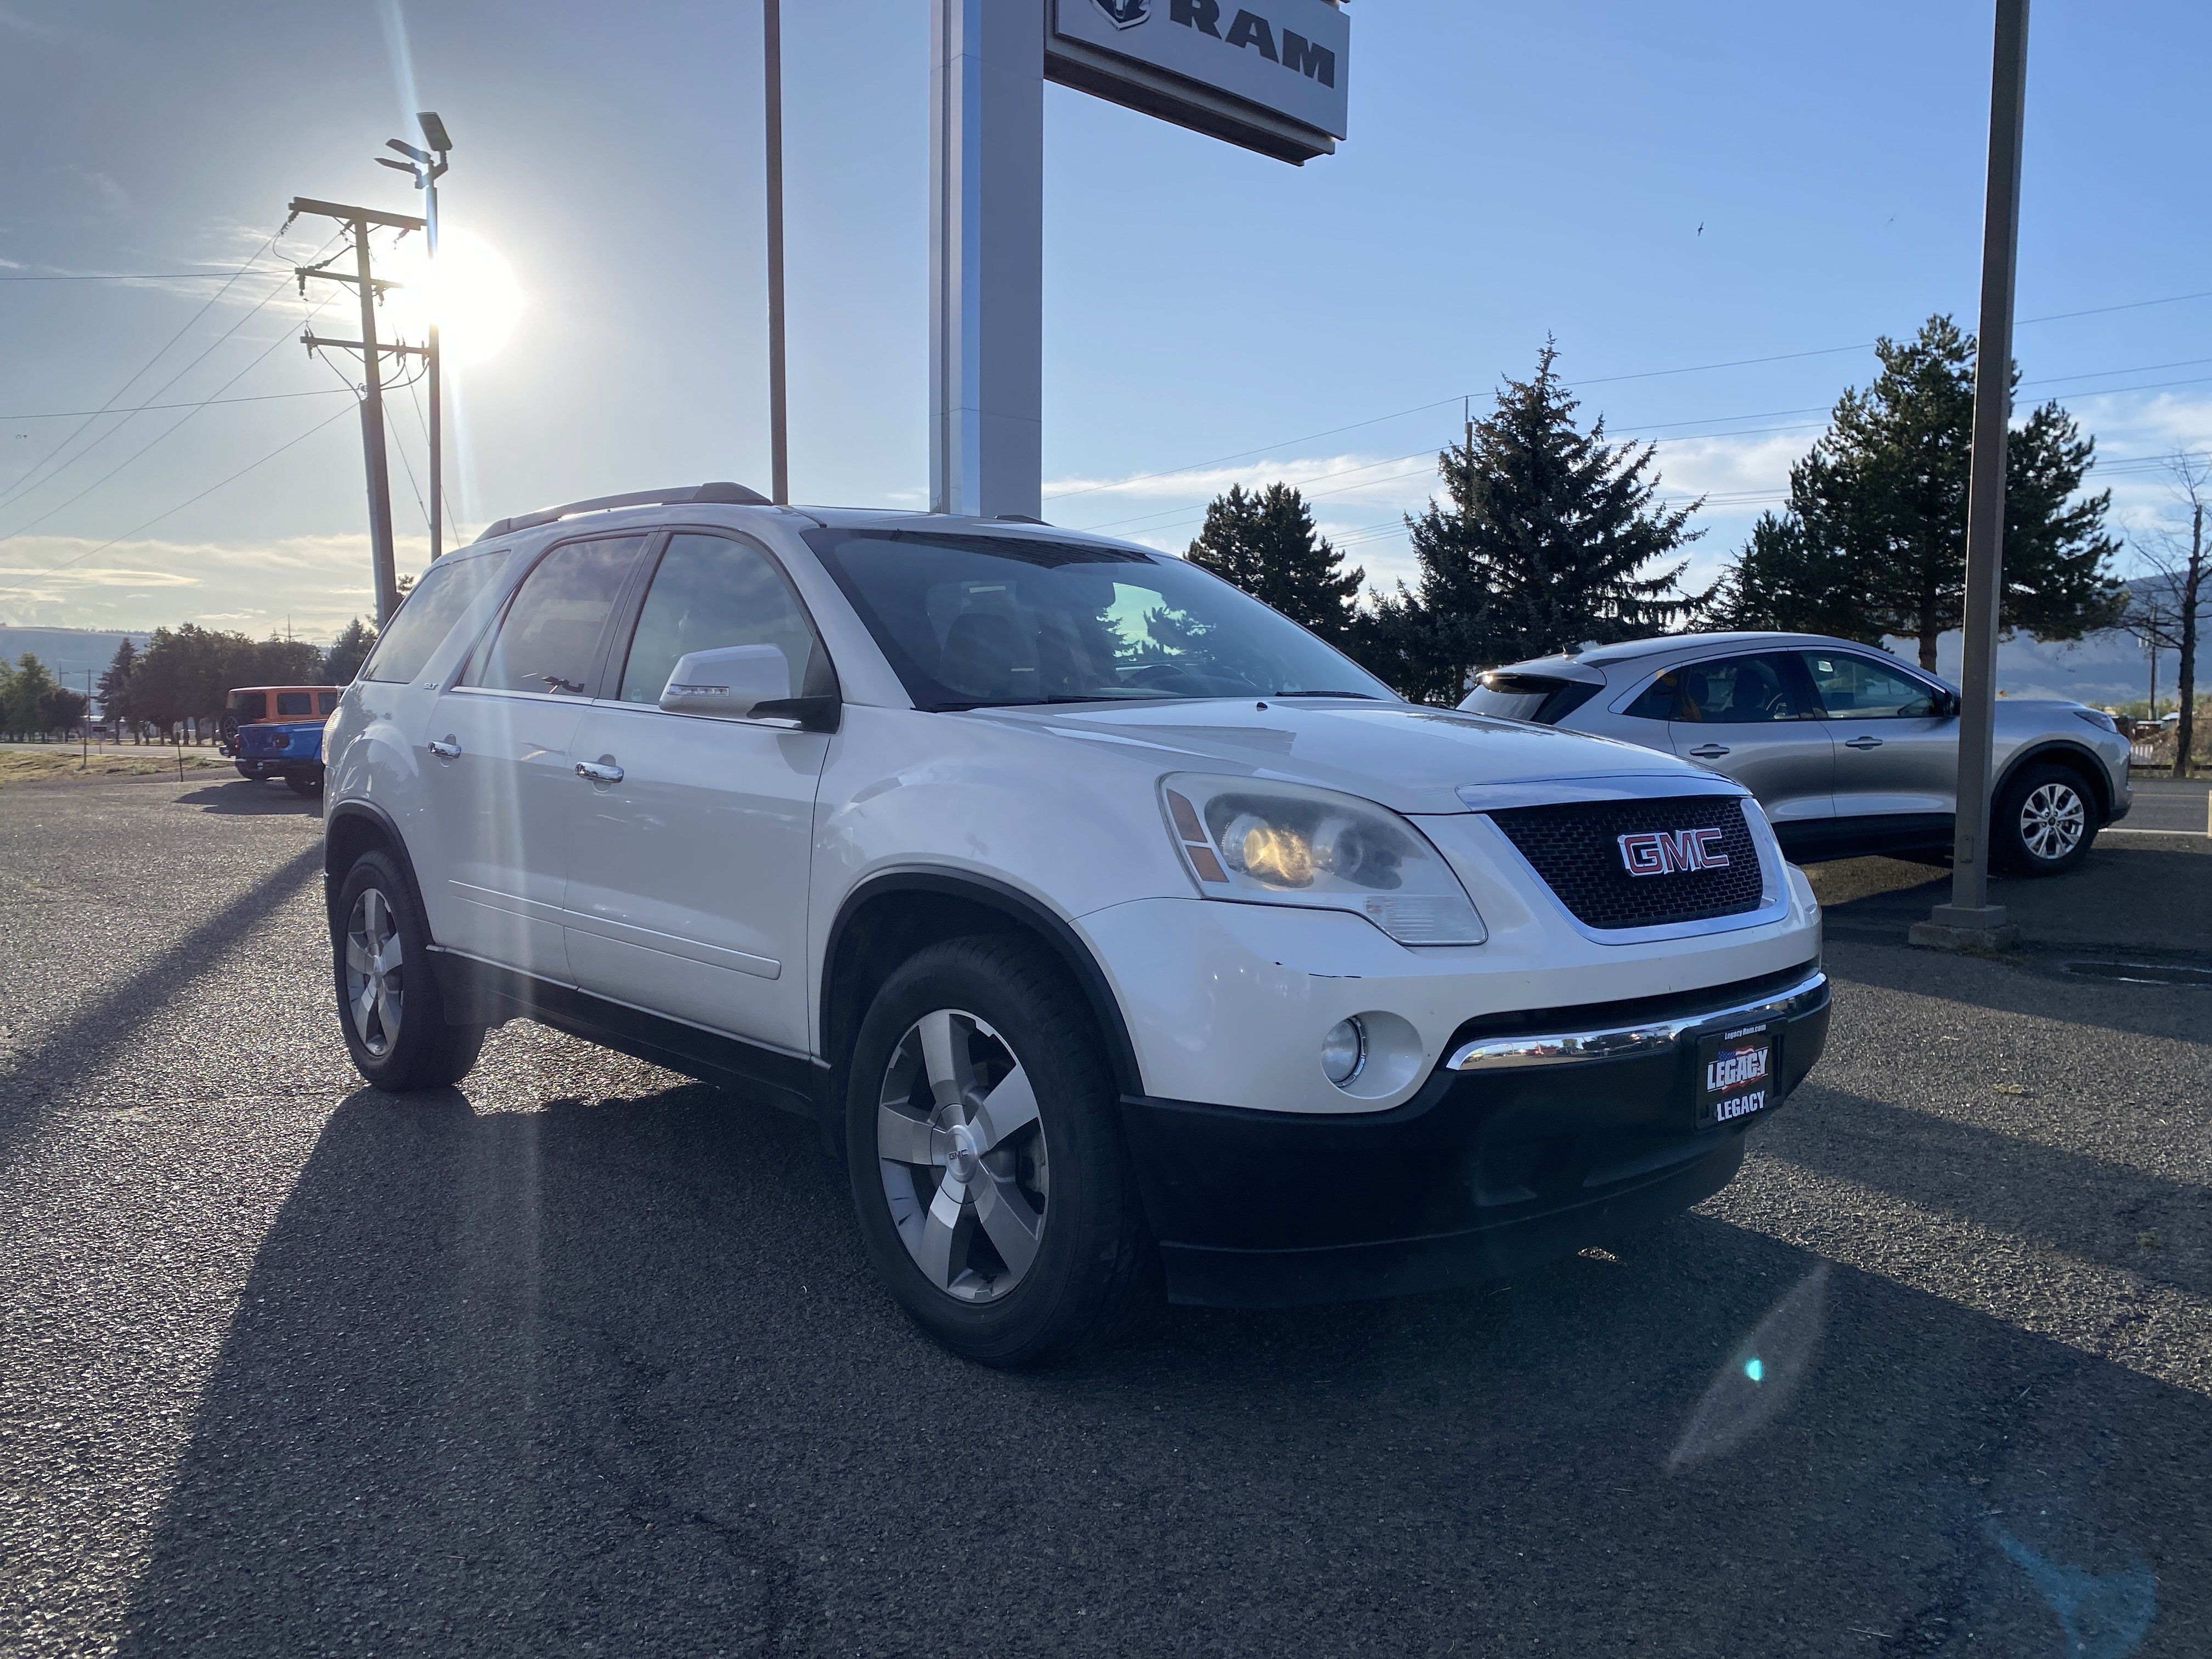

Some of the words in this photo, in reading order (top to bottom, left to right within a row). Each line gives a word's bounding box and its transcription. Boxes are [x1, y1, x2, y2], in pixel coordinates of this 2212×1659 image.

[1170, 0, 1335, 89] RAM
[1617, 828, 1729, 877] GMC
[1707, 1048, 1768, 1091] LEGACY
[1717, 1090, 1765, 1121] LEGACY
[949, 1149, 968, 1160] GMC
